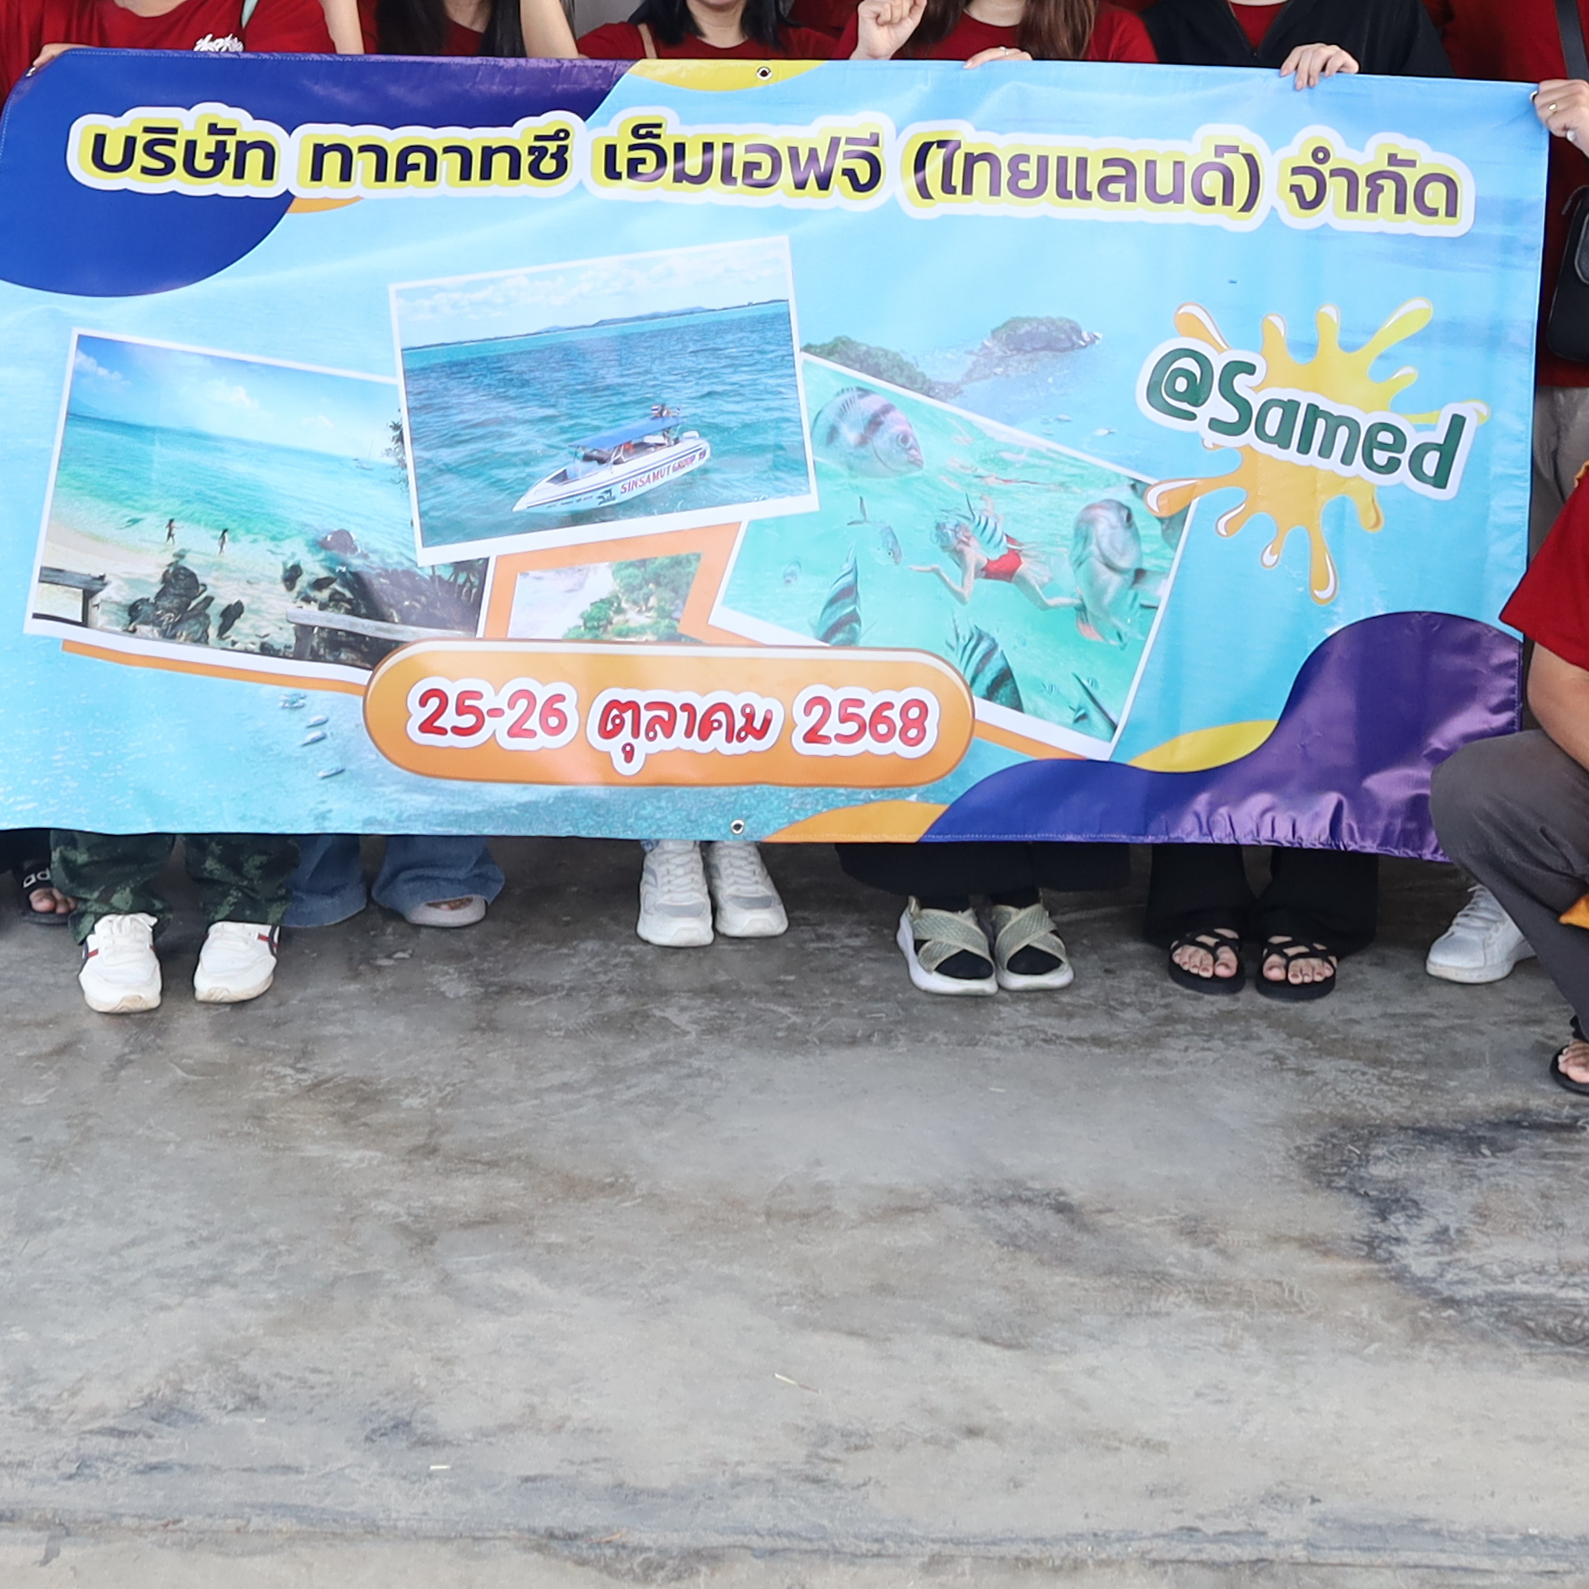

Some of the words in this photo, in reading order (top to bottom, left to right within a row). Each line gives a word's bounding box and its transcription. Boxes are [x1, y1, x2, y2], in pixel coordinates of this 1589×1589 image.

[89, 121, 278, 182] บริษัท
[311, 128, 572, 183] ทาคาทซึ
[602, 122, 883, 194] เอ็มเอฟจี
[912, 138, 1262, 214] (ไทยแลนด์)
[1288, 145, 1460, 218] จำกัด
[1145, 347, 1468, 490] @Samed
[620, 465, 671, 494] SINSAMUT
[417, 687, 570, 739] 25-26
[596, 698, 774, 764] ตุลาคม
[801, 695, 929, 748] 2568
